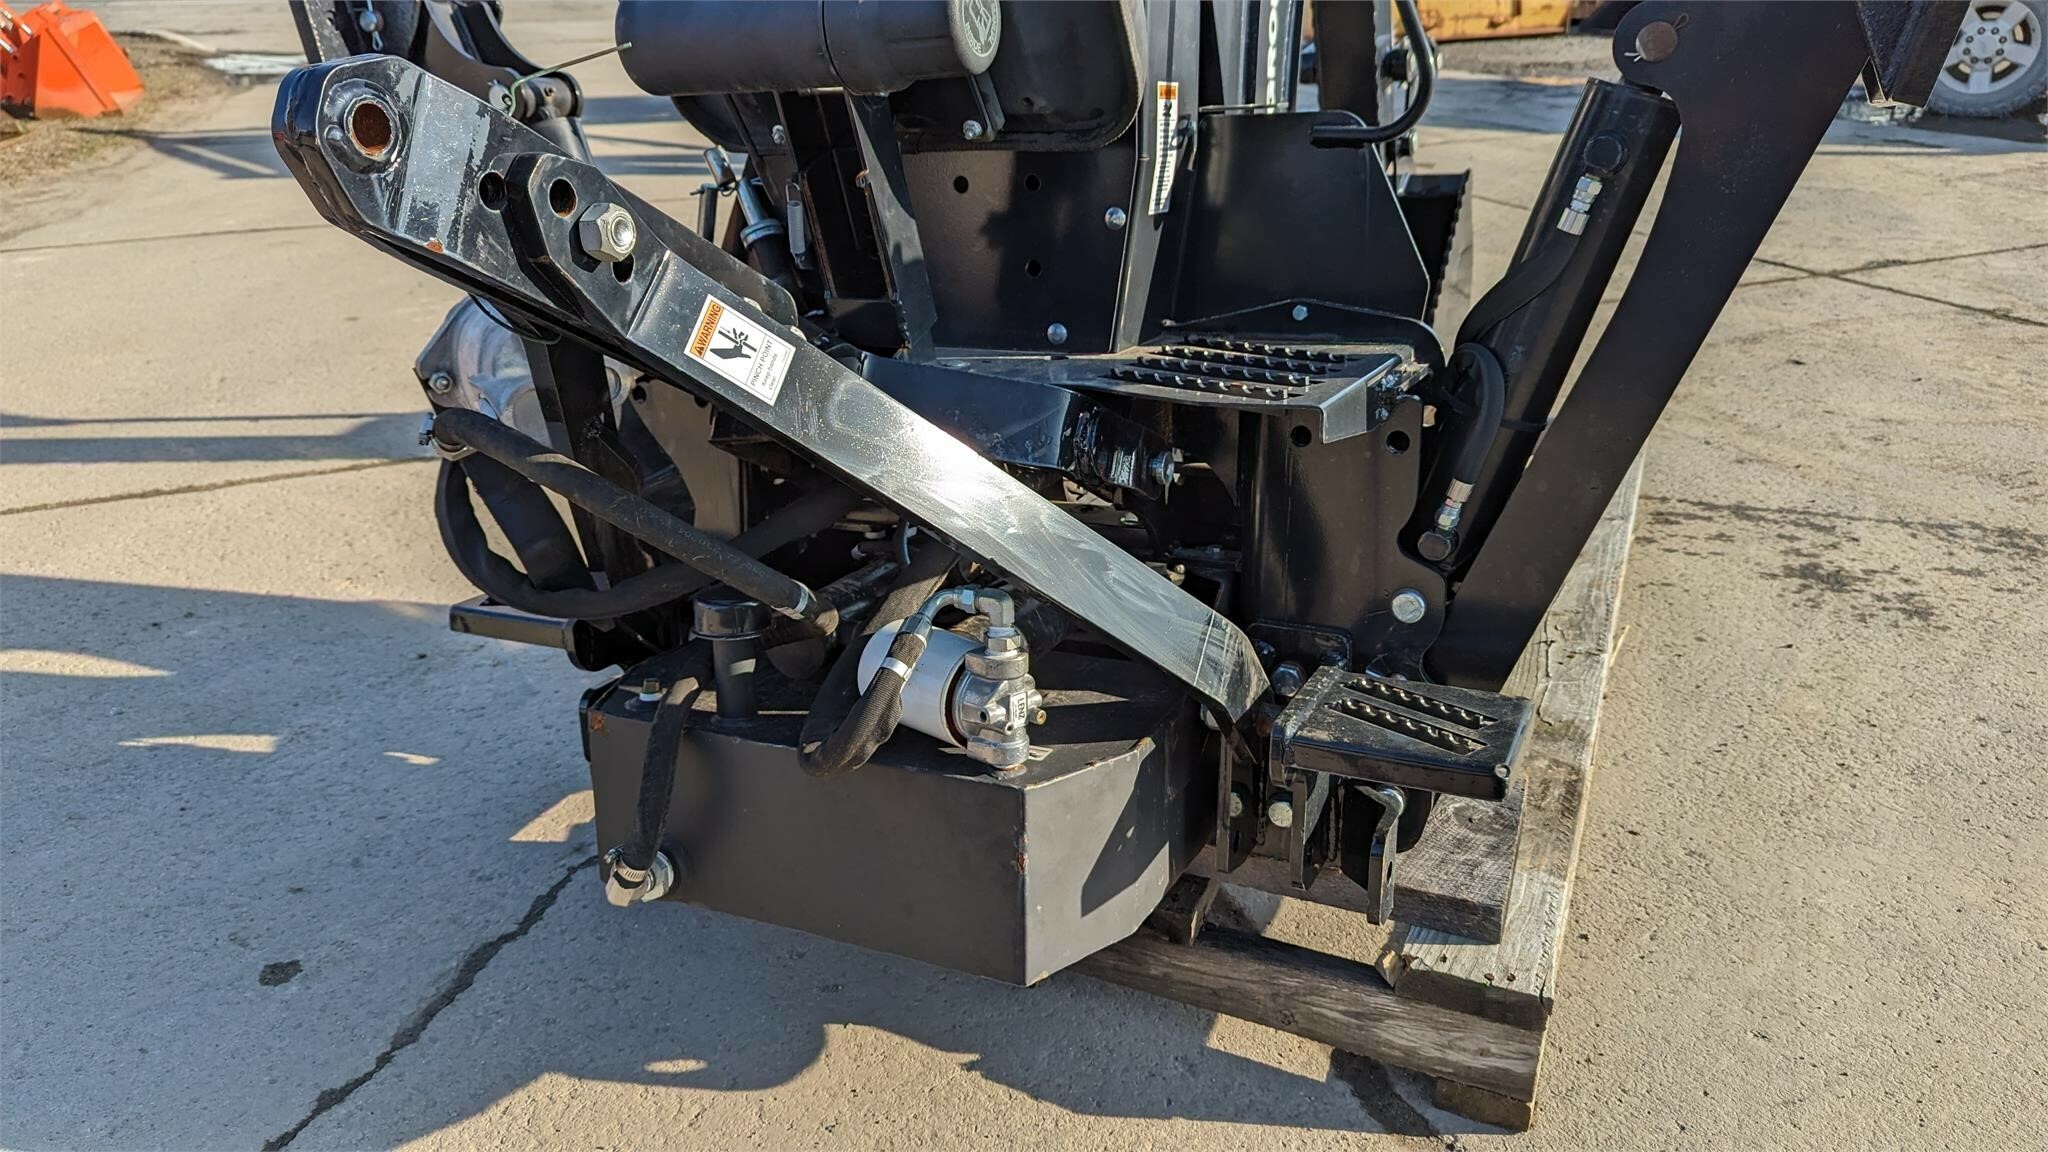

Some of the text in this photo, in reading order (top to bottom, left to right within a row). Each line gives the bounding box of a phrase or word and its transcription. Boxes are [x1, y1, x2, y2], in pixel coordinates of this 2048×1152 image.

[697, 304, 721, 348] WARNING
[750, 340, 773, 386] PINCH POINT
[767, 354, 778, 371] hands
[1017, 698, 1026, 720] LENZ
